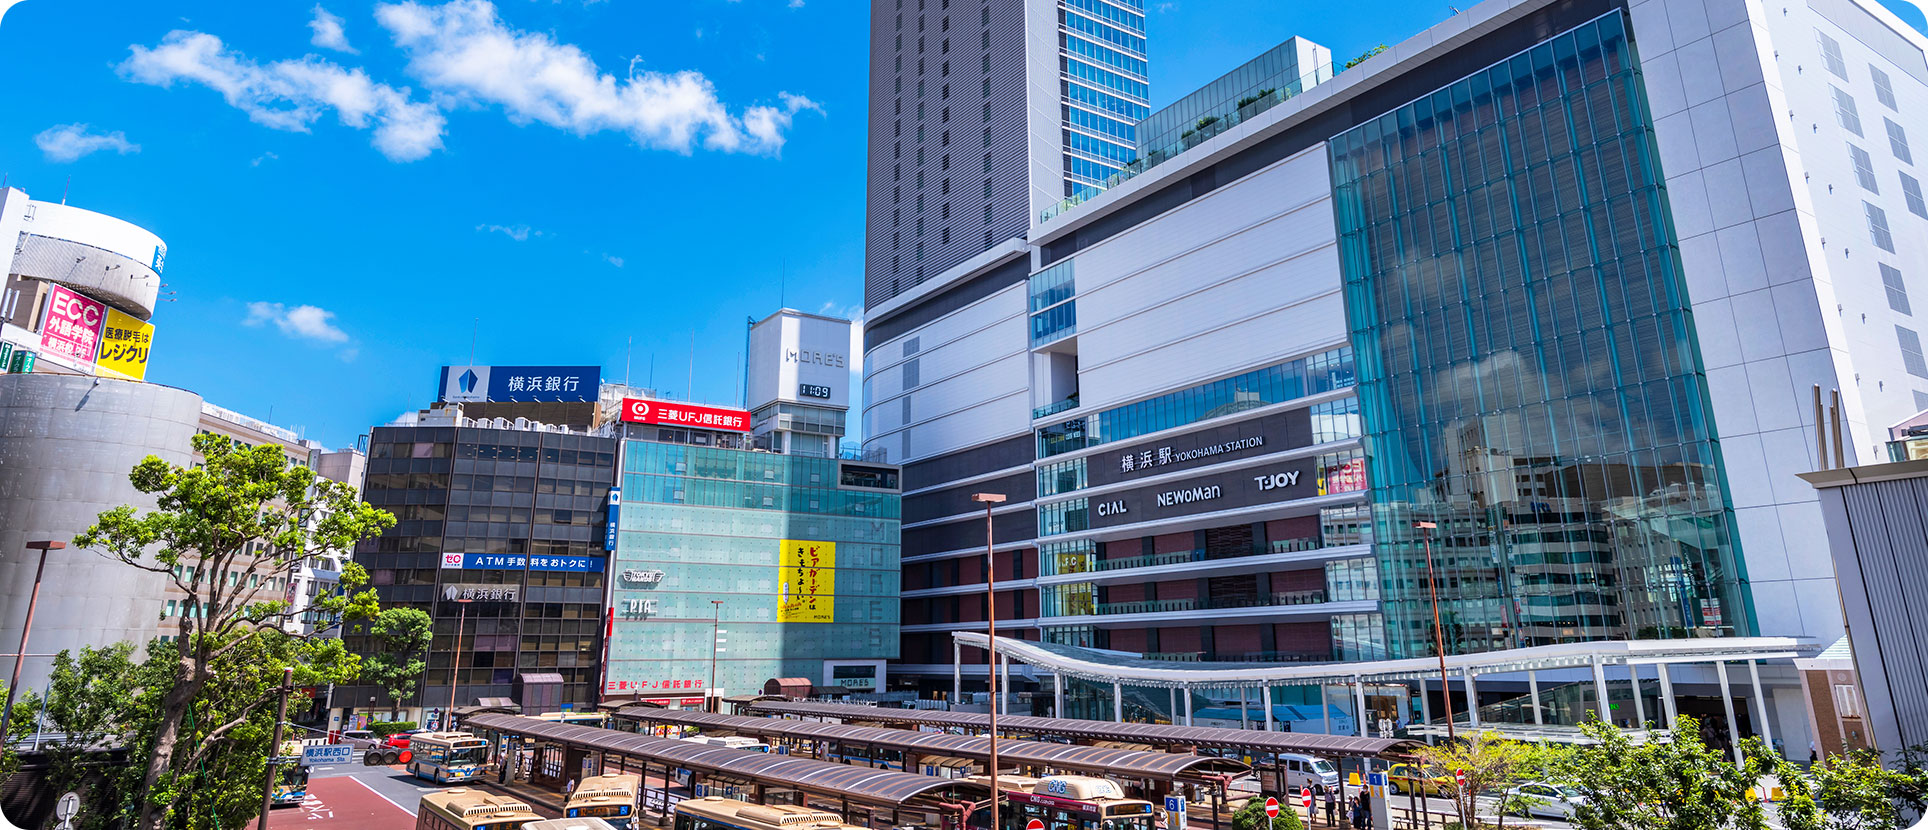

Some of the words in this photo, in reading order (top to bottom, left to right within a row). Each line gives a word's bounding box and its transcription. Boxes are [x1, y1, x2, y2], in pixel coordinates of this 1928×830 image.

[52, 291, 99, 326] ECC
[48, 316, 95, 346] 外語学院
[105, 327, 149, 344] 医療脱毛は
[100, 342, 148, 363] レジクリ
[508, 376, 579, 391] 横浜銀行
[802, 385, 829, 397] 11:09
[658, 408, 742, 427] 三菱UFJ信託銀行
[1121, 446, 1172, 473] 横浜駅
[1175, 444, 1223, 462] YOKOHAMA
[1225, 436, 1263, 452] STATION
[1098, 500, 1127, 516] CIAL
[1157, 485, 1221, 507] NEWoMan
[608, 522, 616, 546] 横浜銀行
[809, 545, 820, 610] ビアガーデンは
[462, 587, 517, 600] 横浜銀行
[608, 680, 702, 690] 三菱UFJ信託銀行
[305, 747, 350, 757] 横浜駅西口
[1048, 780, 1067, 794] CNG
[1169, 800, 1175, 810] 6
